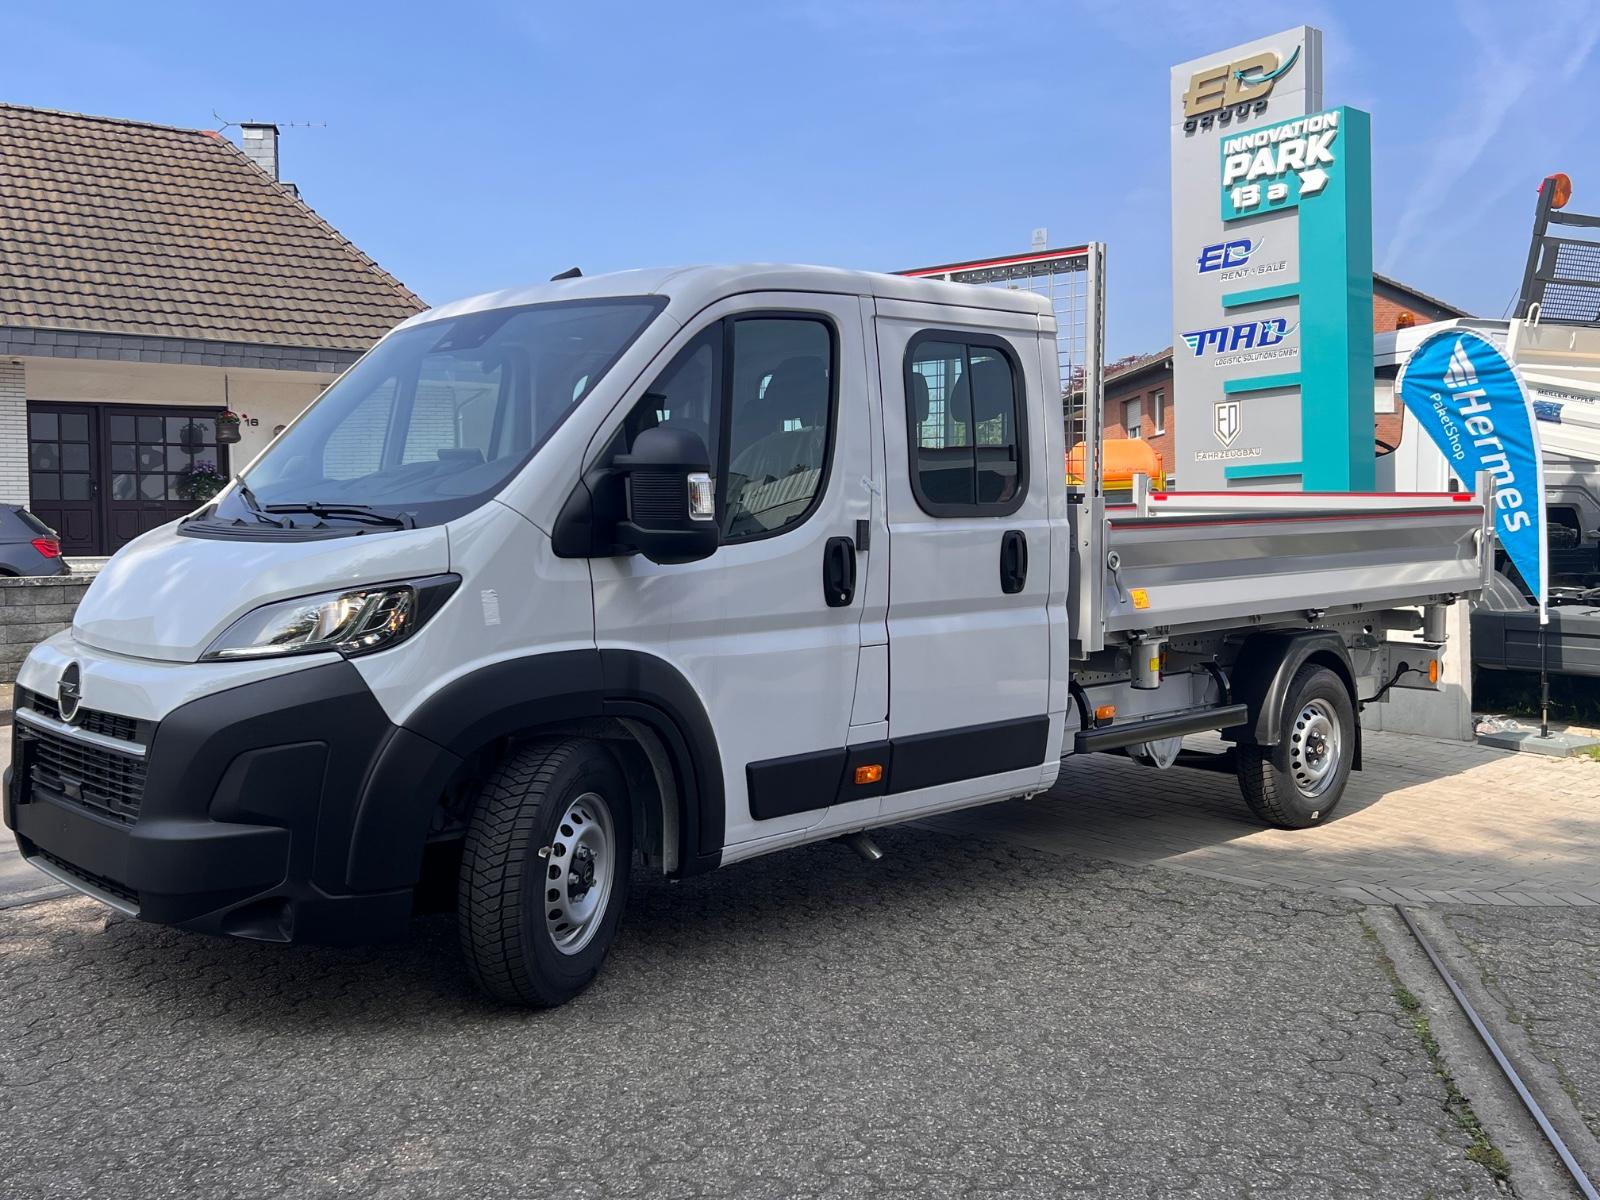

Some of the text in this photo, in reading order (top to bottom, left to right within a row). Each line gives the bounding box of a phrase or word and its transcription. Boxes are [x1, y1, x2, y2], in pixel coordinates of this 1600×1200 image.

[1183, 52, 1279, 118] ED
[1183, 100, 1268, 132] GROUP
[1223, 111, 1341, 155] INNOVATION
[1222, 131, 1338, 186] PARK
[1230, 183, 1288, 208] 13 a
[1198, 239, 1252, 274] ED
[1220, 260, 1286, 281] RENT SALE
[1181, 318, 1288, 356] MAD
[1214, 356, 1242, 367] LOGISTIC
[1243, 350, 1277, 362] SOLUTIONS
[1429, 392, 1466, 461] PaketShop
[1195, 448, 1262, 461] FAHRZEUGBAU
[1453, 387, 1531, 534] Hermes
